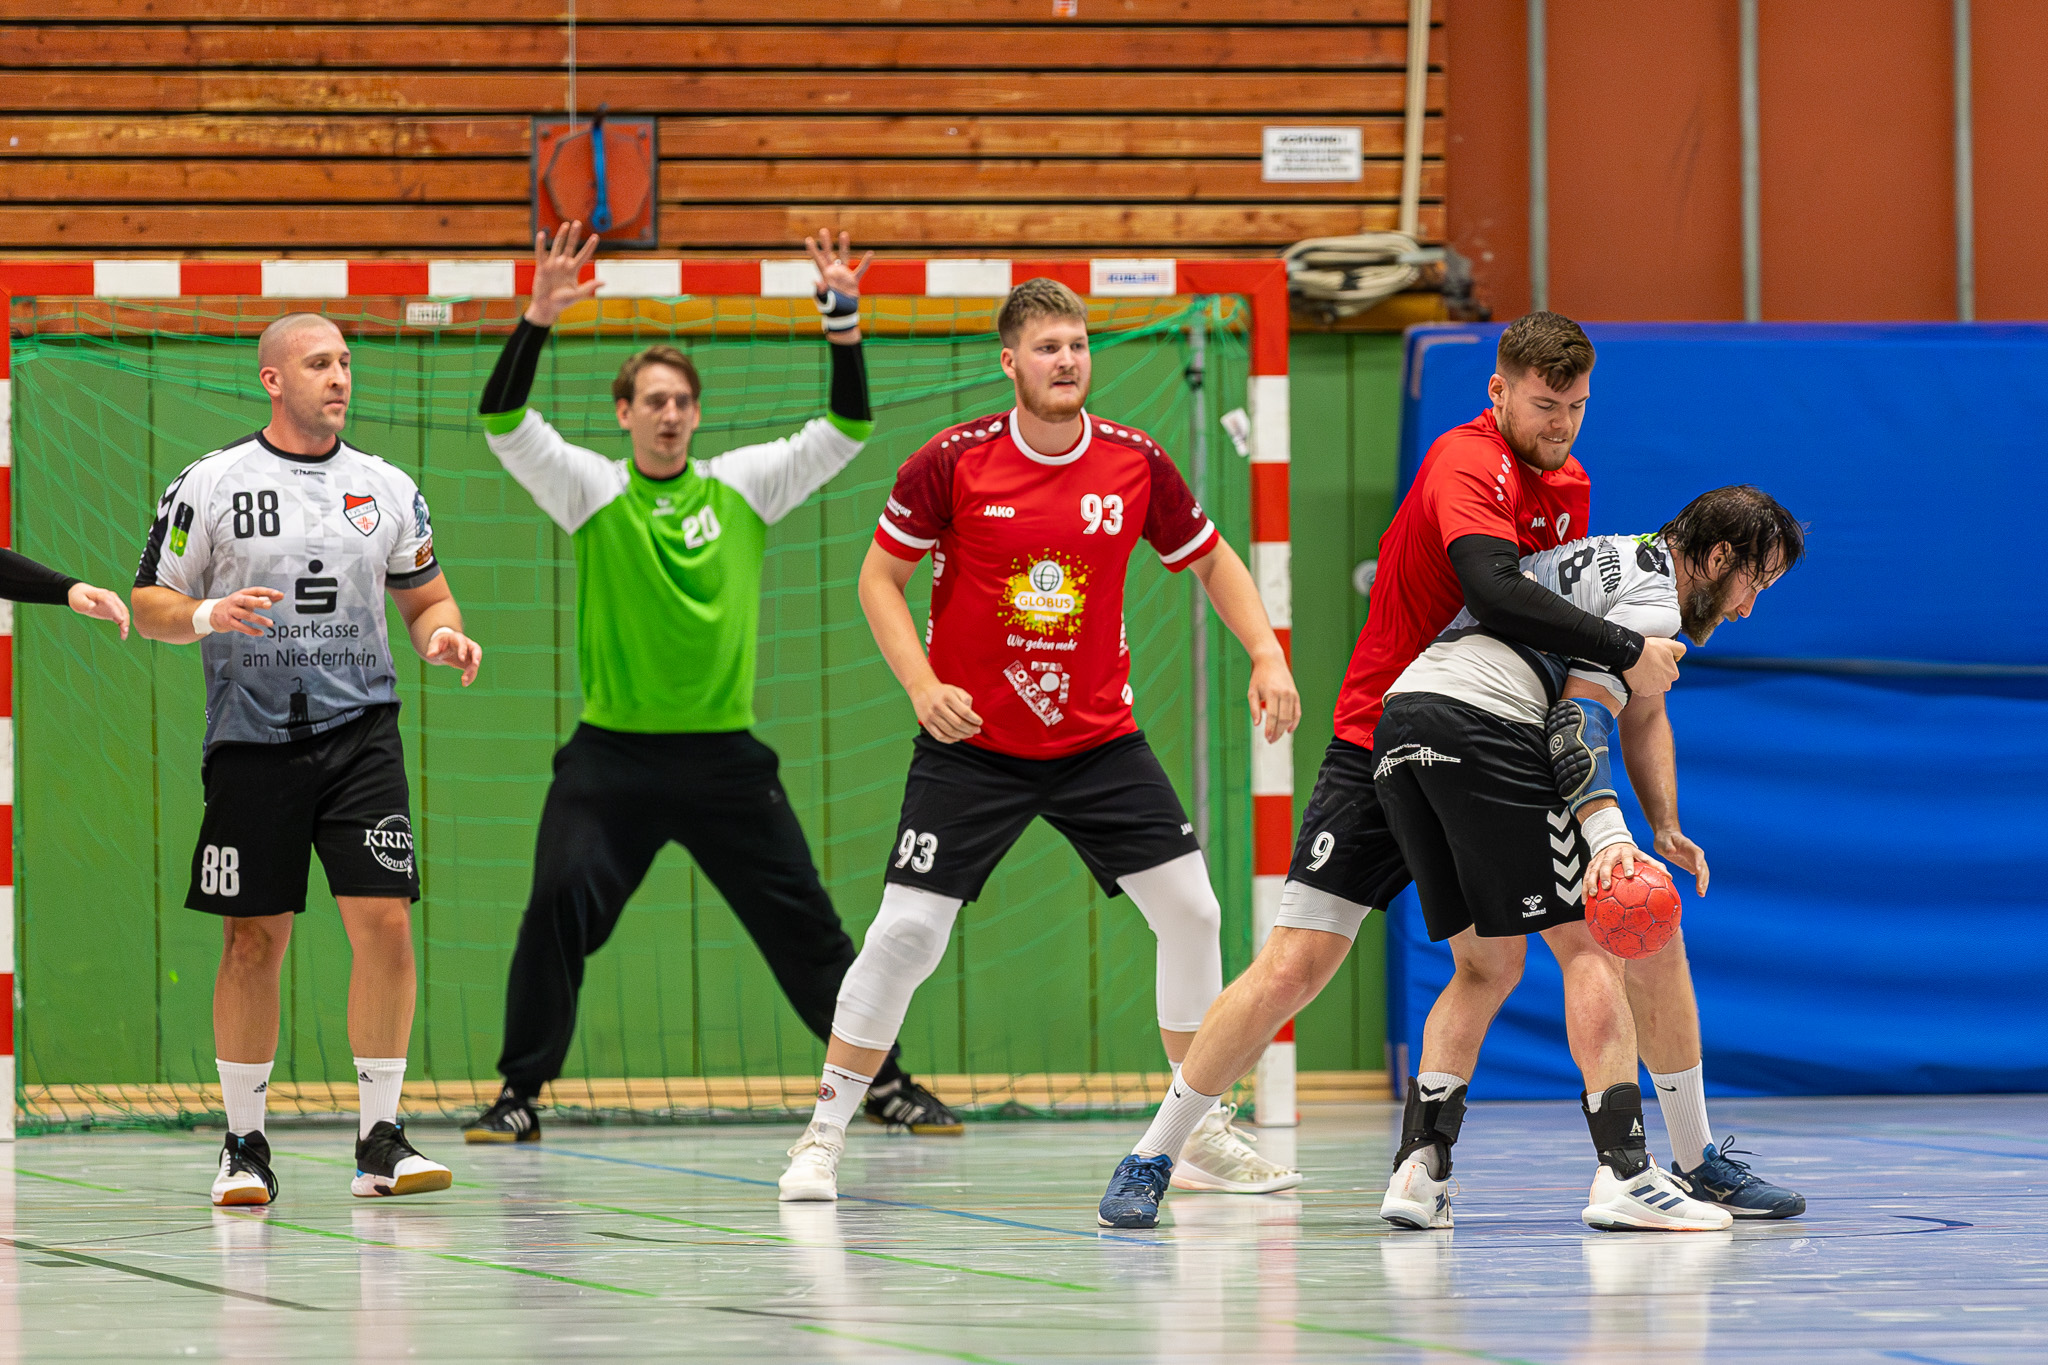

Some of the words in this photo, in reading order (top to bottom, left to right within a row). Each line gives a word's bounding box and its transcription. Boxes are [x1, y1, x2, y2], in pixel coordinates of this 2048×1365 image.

[233, 490, 280, 539] 88
[682, 505, 721, 549] 20
[983, 505, 1015, 518] JAKO
[1080, 493, 1124, 536] 93
[1019, 595, 1071, 609] GLOBUS
[267, 620, 359, 643] Sparkasse
[1007, 633, 1026, 647] Wir
[1025, 637, 1055, 652] geben
[1055, 638, 1078, 651] mehr
[243, 652, 269, 667] am
[276, 647, 377, 667] Niederrhein
[895, 829, 938, 873] 93
[1306, 831, 1335, 871] 9
[201, 844, 240, 897] 88
[1522, 907, 1546, 918] hummel
